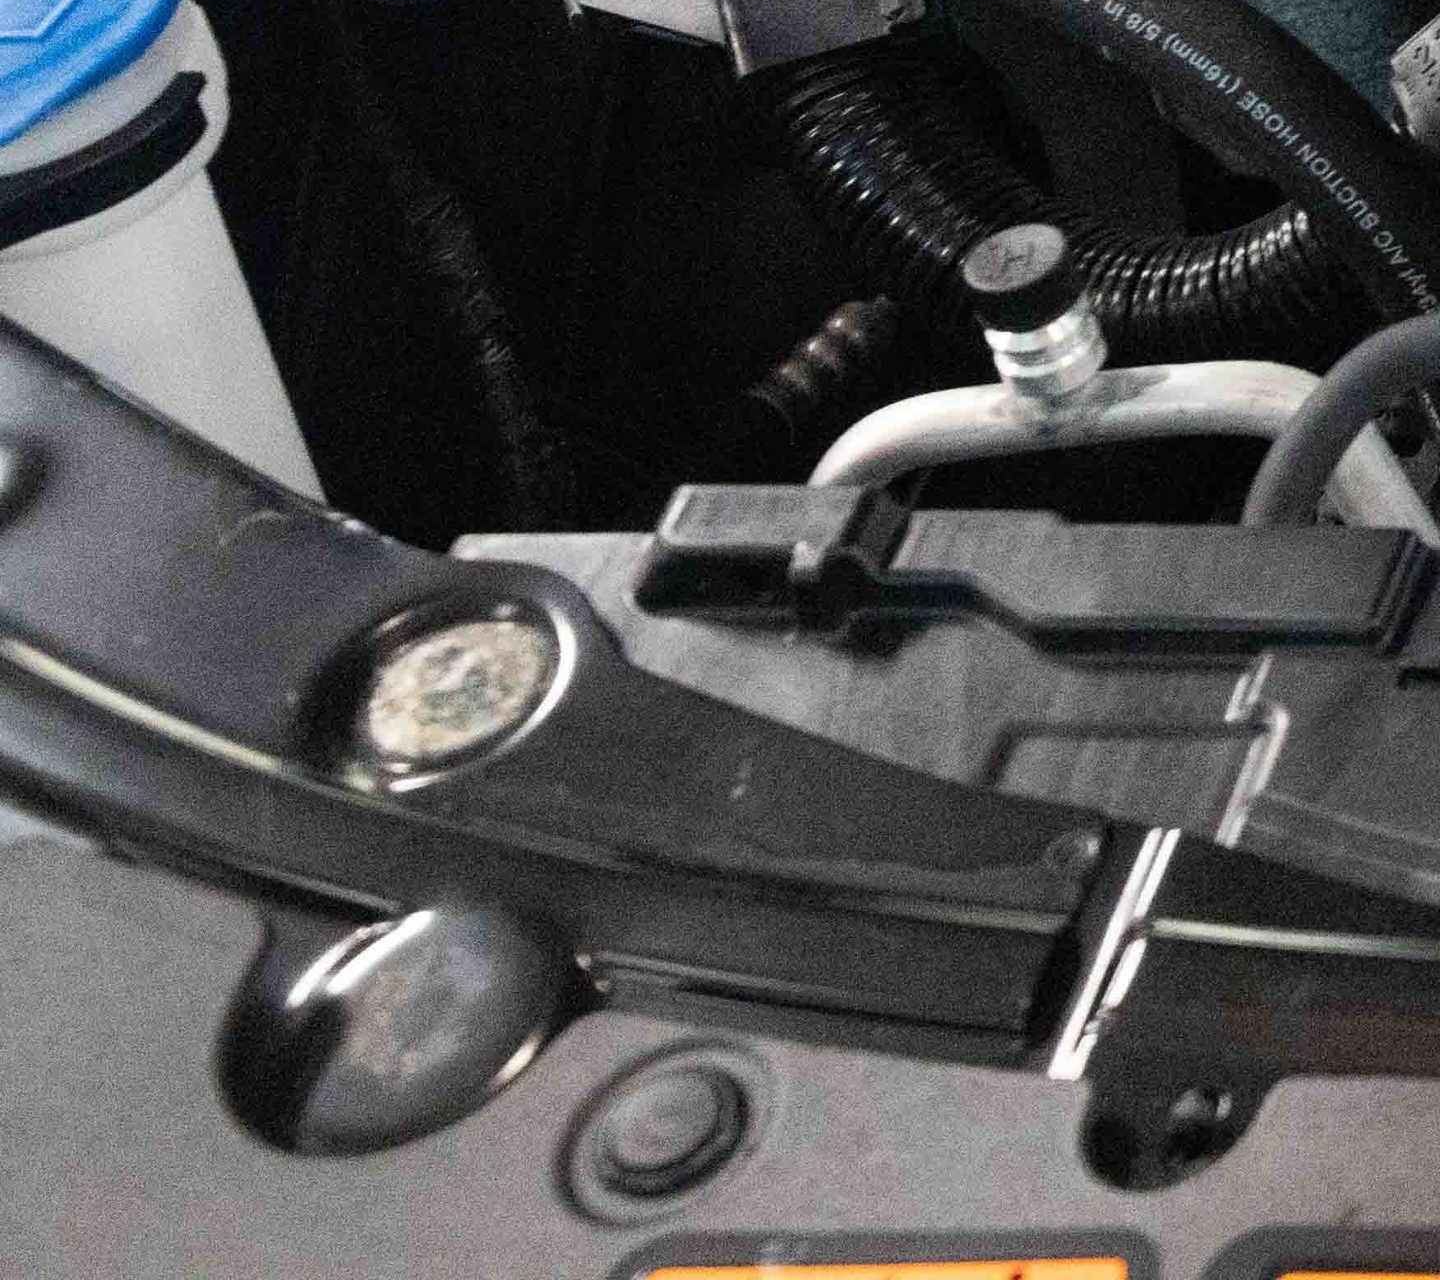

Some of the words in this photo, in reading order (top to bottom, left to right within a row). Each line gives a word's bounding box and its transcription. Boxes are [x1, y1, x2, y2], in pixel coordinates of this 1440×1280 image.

[1103, 0, 1127, 21] in
[1161, 32, 1243, 95] (16mm)
[1236, 90, 1302, 146] HOSE
[1295, 143, 1381, 230] SUCTION
[1374, 231, 1409, 265] A/C
